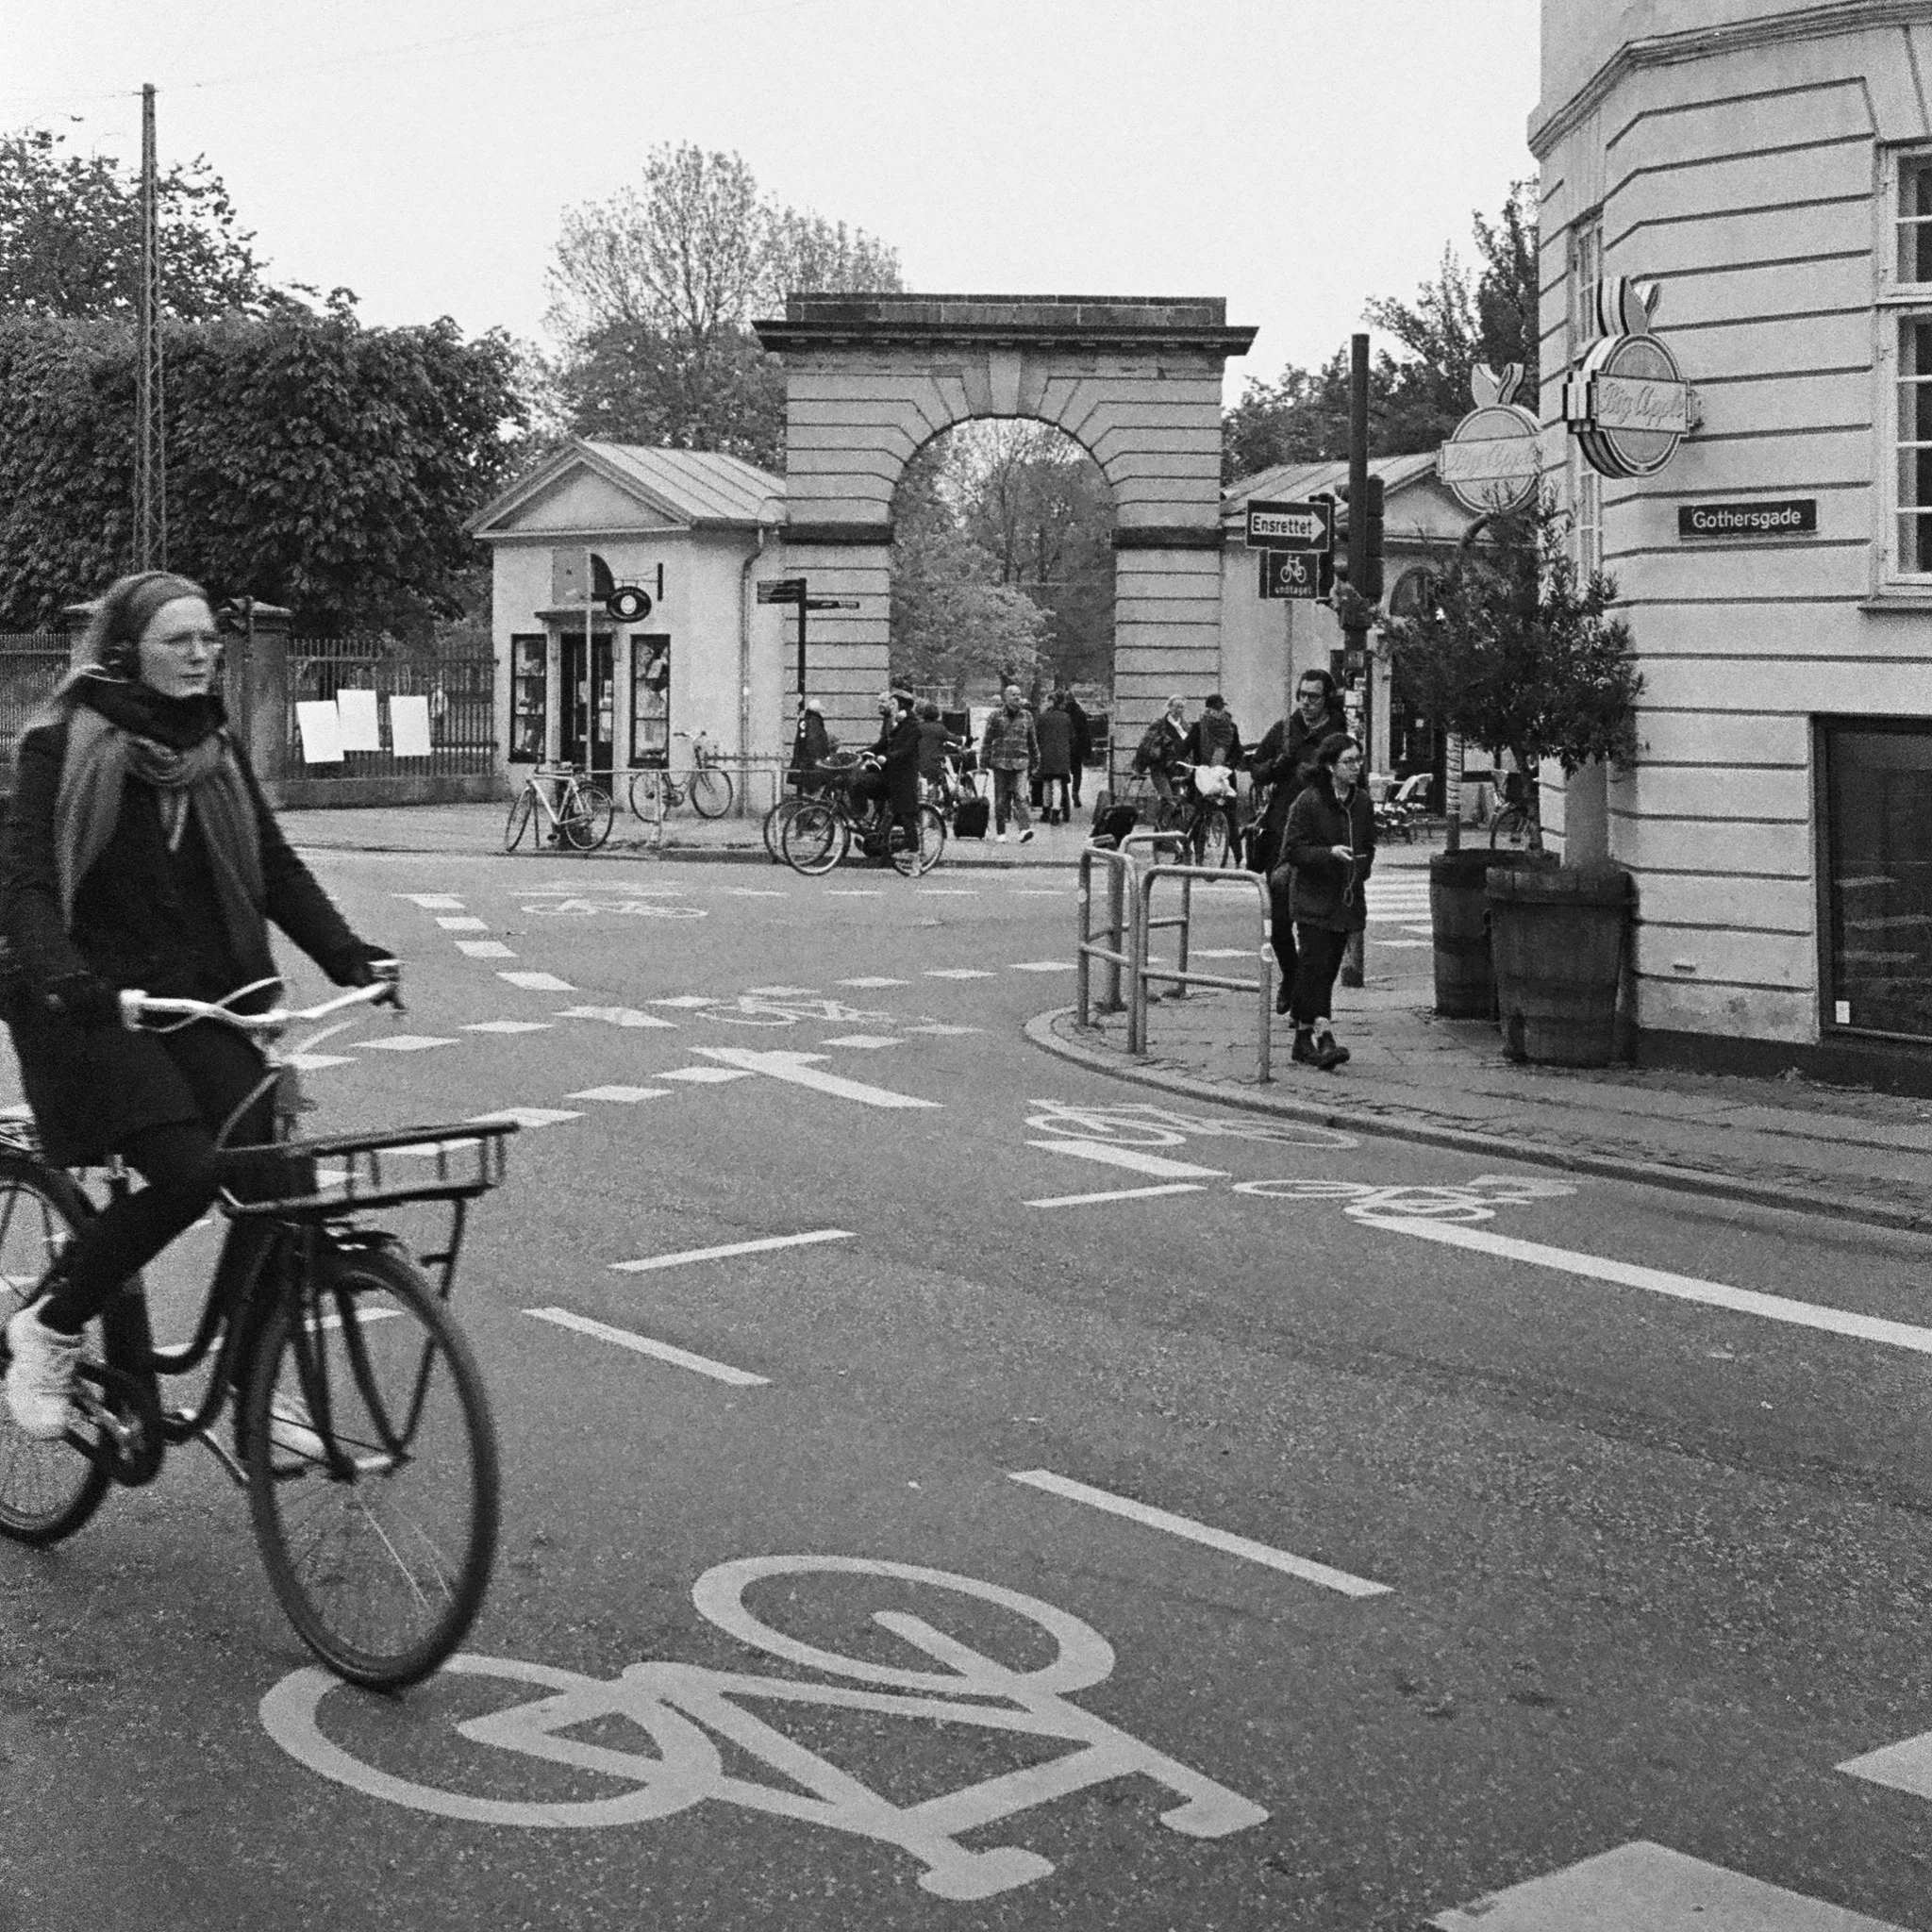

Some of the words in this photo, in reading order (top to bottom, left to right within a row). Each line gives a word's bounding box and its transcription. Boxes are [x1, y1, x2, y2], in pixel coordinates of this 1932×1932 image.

[1252, 515, 1313, 535] Ensrettet
[1693, 508, 1802, 530] Gothersgade
[1274, 585, 1312, 596] undtaget
